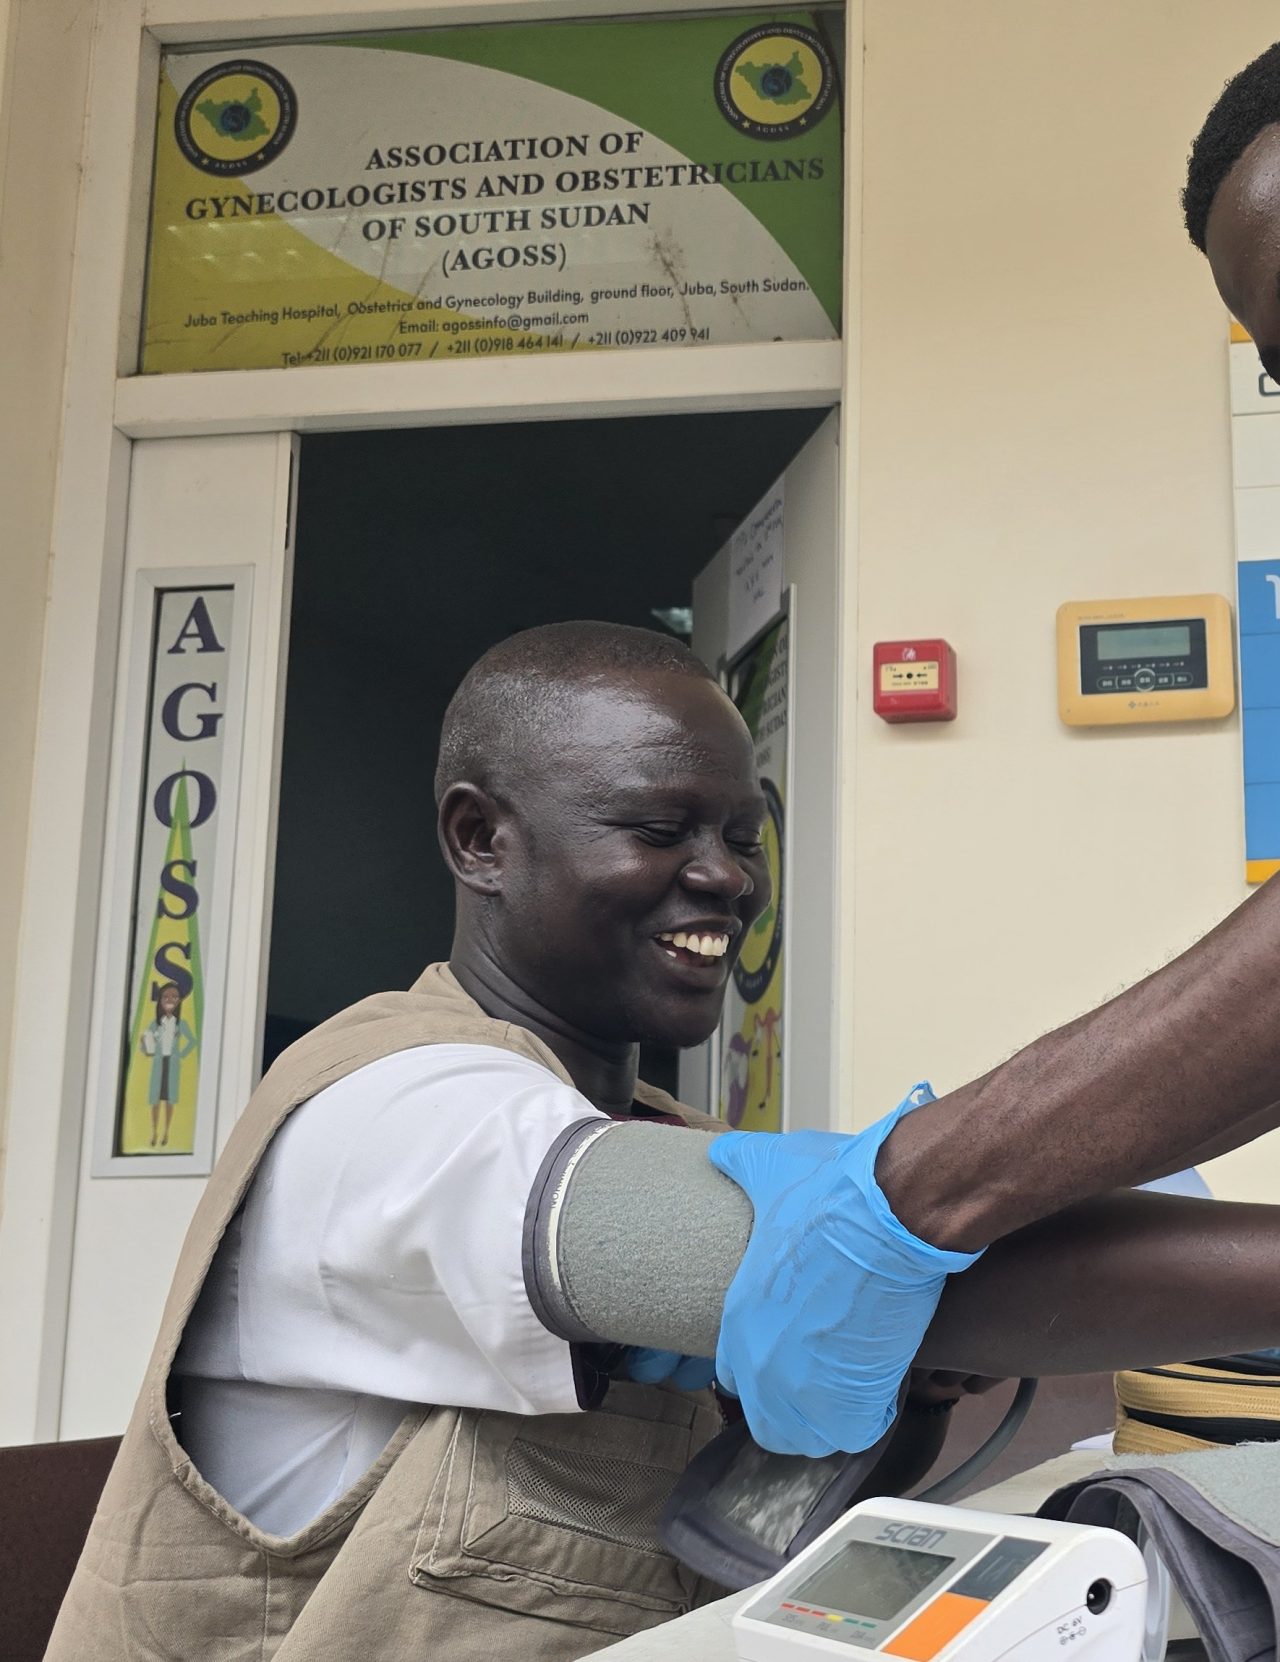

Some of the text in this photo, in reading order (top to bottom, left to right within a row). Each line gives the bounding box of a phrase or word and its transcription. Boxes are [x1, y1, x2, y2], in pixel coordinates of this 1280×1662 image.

[365, 131, 644, 171] ASSOCIATION OF
[185, 158, 824, 221] GYNECOLOGISTS AND OBSTETRICIANS
[362, 202, 651, 242] OF SOUTH SUDAN
[441, 243, 567, 278] (AGOSS)
[184, 313, 217, 328] Juba
[221, 310, 279, 325] Teaching
[282, 303, 341, 320] Hospital,
[347, 300, 414, 315] Obstetrics
[416, 297, 442, 311] and
[445, 292, 524, 311] Gynecology
[528, 289, 584, 304] Building,
[590, 284, 638, 304] ground
[640, 283, 674, 300] floor,
[679, 282, 717, 297] Juba,
[720, 280, 760, 295] South
[399, 312, 590, 334] Email: agossinfo@gmail.com
[333, 344, 372, 361] (0)921
[398, 342, 422, 357] 077
[474, 337, 514, 353] (0)918
[588, 331, 612, 346] +211
[615, 329, 658, 346] (0)922
[660, 328, 687, 342] 409
[690, 326, 710, 341] 941
[152, 596, 225, 1002] AGOSS
